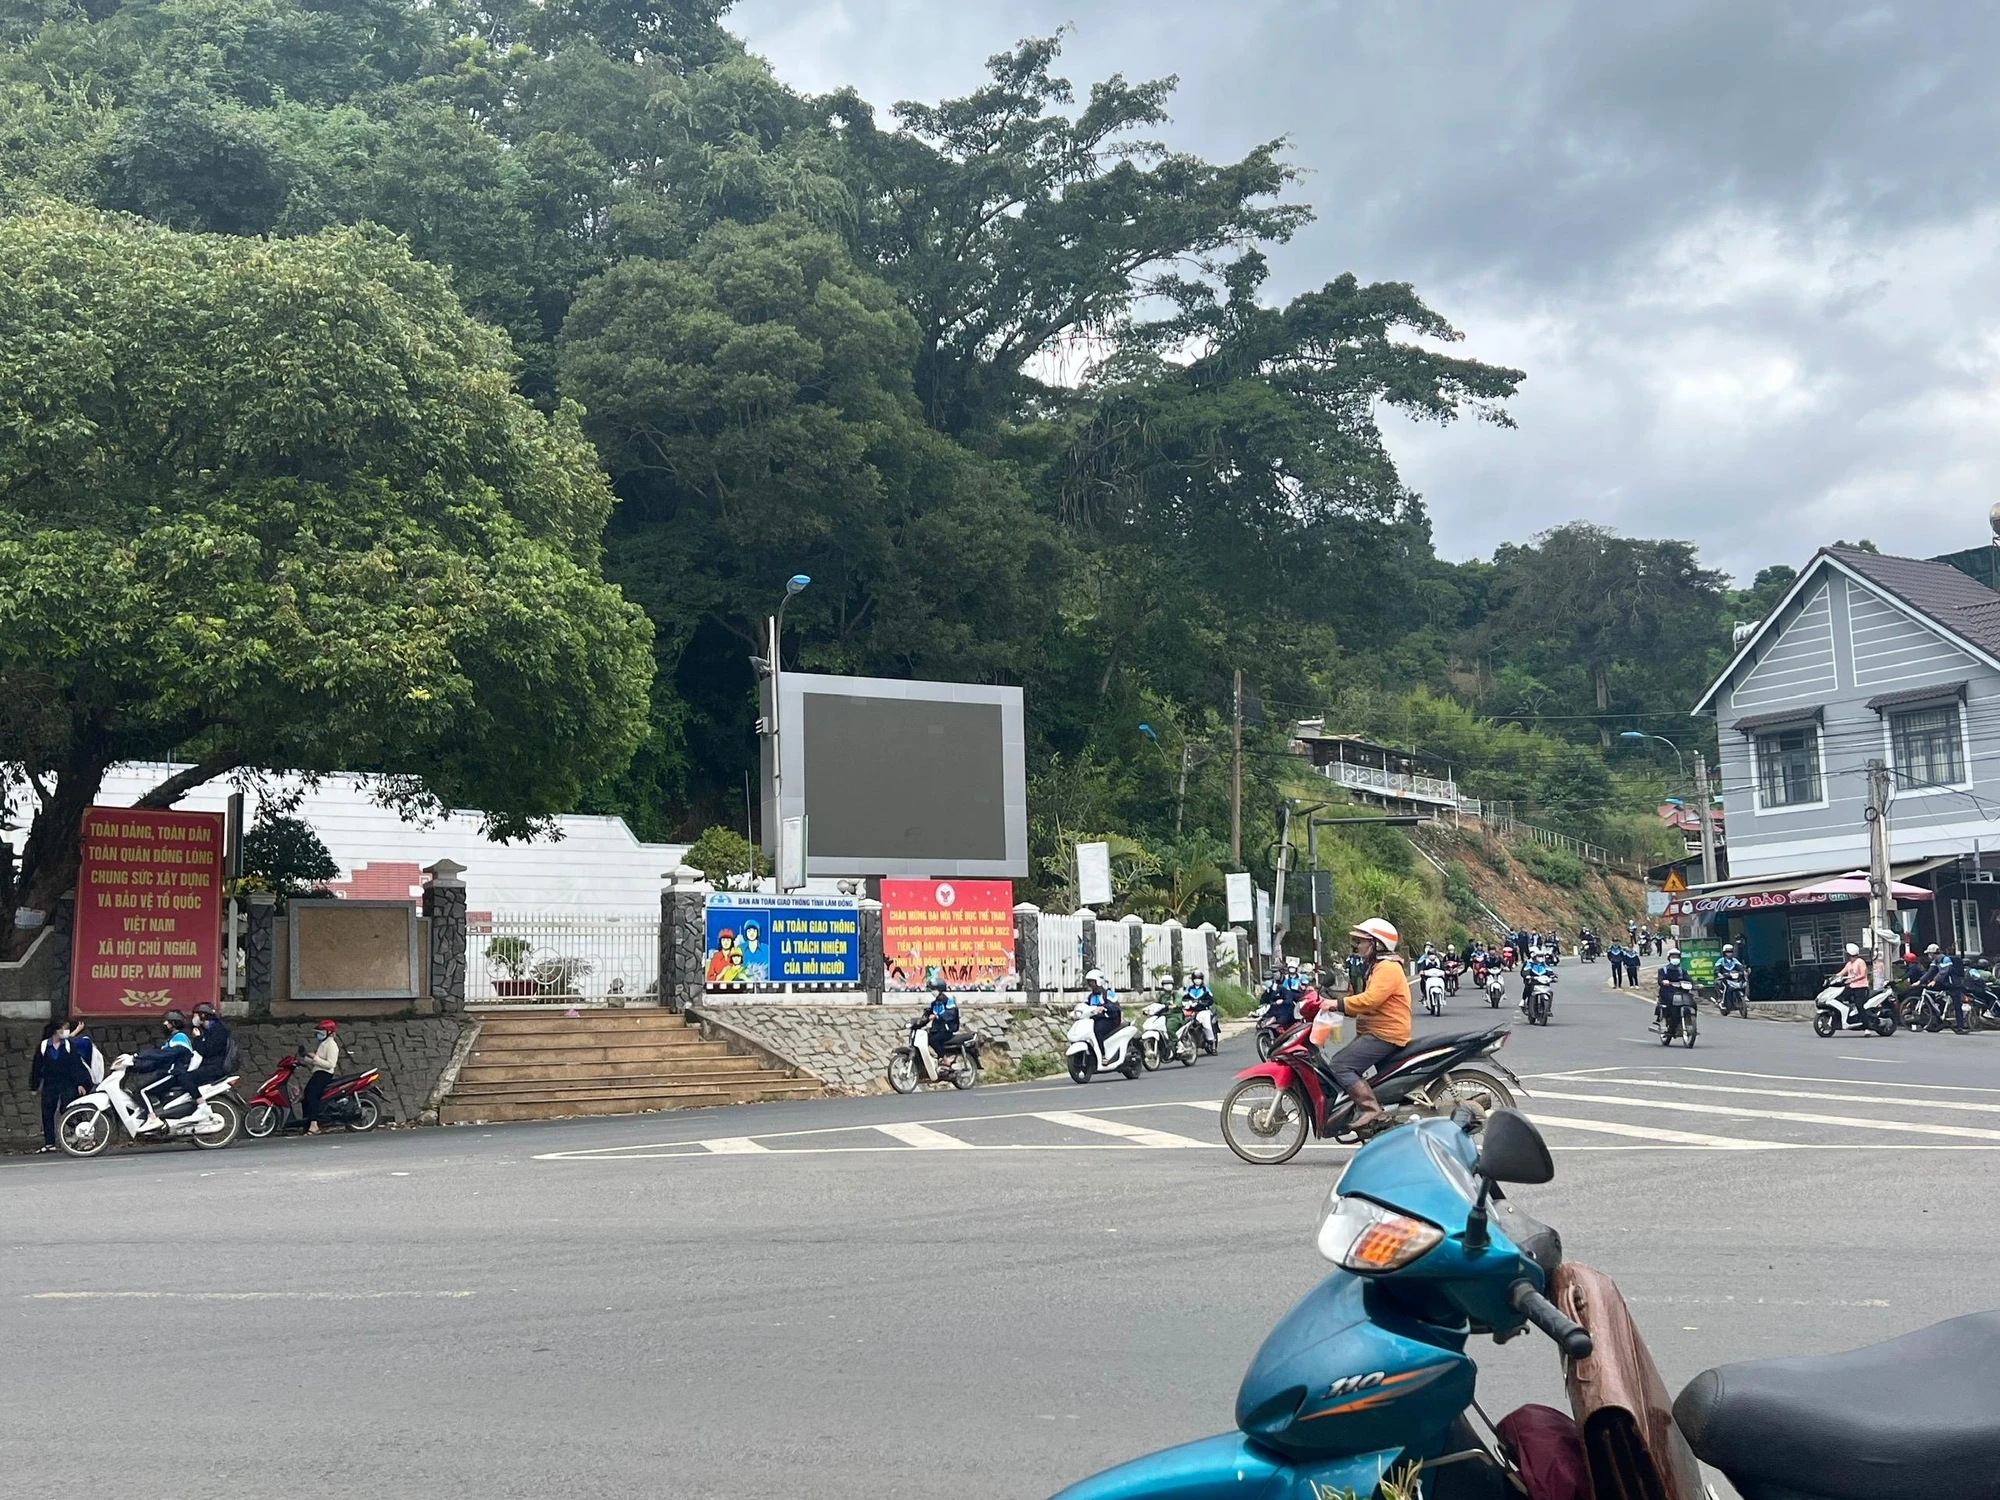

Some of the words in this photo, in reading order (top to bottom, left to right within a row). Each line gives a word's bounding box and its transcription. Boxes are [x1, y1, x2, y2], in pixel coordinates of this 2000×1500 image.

[90, 820, 119, 837] TOÀN
[122, 820, 155, 840] ĐẢNG,
[158, 824, 186, 840] TOÀN
[88, 844, 118, 861] TOÀN
[120, 845, 150, 863] QUÂN
[185, 847, 213, 864] LÒNG
[91, 869, 128, 884] CHUNG
[131, 868, 153, 885] SỨC
[156, 870, 178, 886] XÂY
[180, 872, 210, 889] DỰNG
[98, 891, 112, 908] VÀ
[115, 889, 137, 908] BẢO
[140, 892, 154, 911] VỆ
[157, 890, 171, 908] TỔ
[172, 891, 201, 910] QUỐC
[738, 897, 750, 905] BAN
[1696, 895, 1748, 912] Coffee
[123, 914, 147, 934] VIỆT
[149, 918, 175, 931] NAM
[772, 920, 784, 933] AN
[786, 918, 808, 933] TOÀN
[809, 920, 828, 933] GIAO
[829, 918, 855, 934] THÔNG
[98, 938, 114, 955] XÃ
[117, 937, 135, 958] HỘI
[138, 937, 160, 955] CHỦ
[163, 939, 197, 955] NGHĨA
[781, 938, 792, 954] LÀ
[793, 938, 819, 954] TRÁCH
[821, 939, 847, 956] NHIỆM
[91, 961, 118, 978] GIÀU
[121, 965, 144, 982] ĐẸP,
[147, 962, 170, 978] VĂN
[172, 965, 202, 978] MINH
[784, 958, 800, 974] CỦA
[803, 957, 818, 974] MỖI
[820, 960, 844, 974] NGƯỜI
[1321, 1370, 1386, 1399] 110
